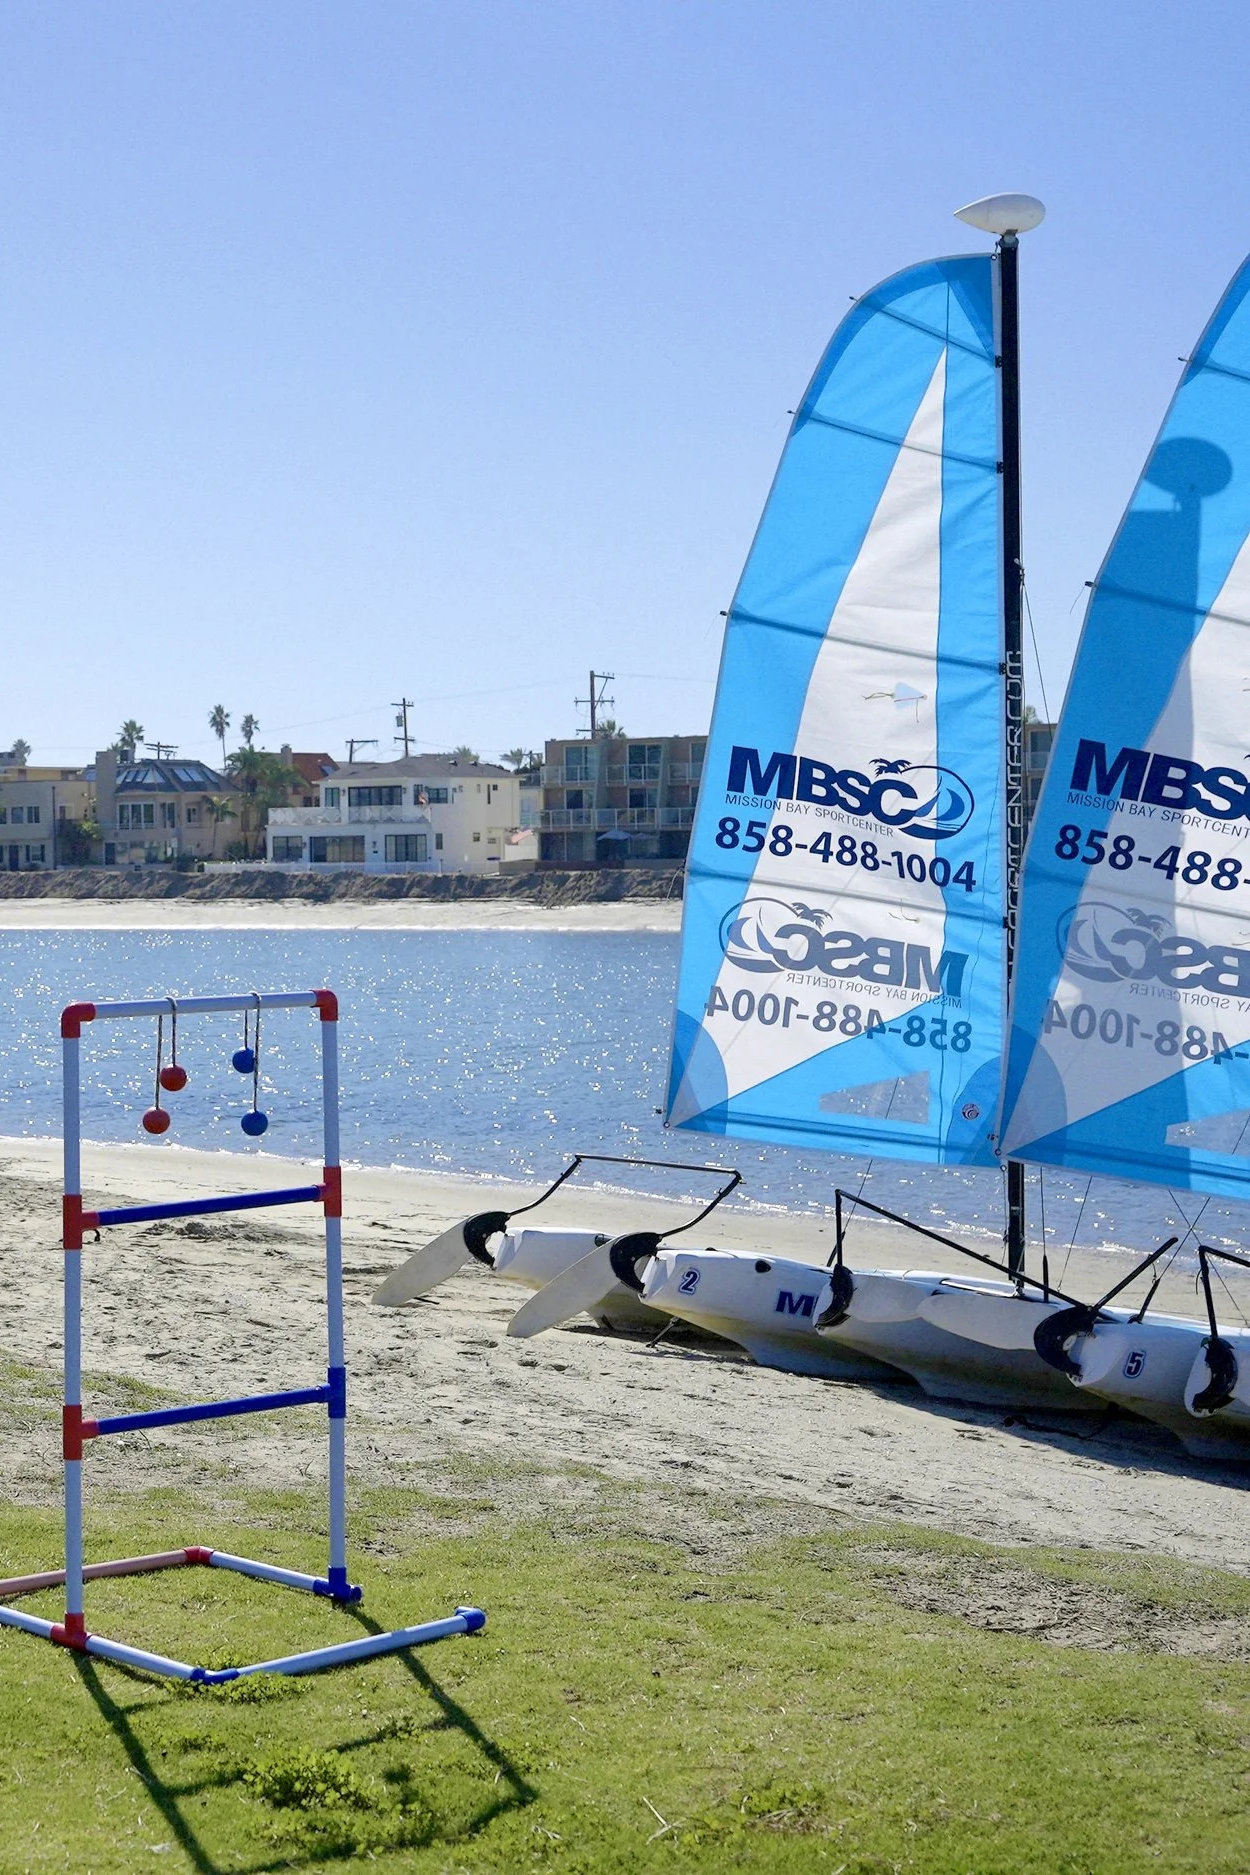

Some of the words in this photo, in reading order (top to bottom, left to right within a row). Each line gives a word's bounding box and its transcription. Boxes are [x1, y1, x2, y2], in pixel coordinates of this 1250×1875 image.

[726, 745, 918, 826] MBSC
[1069, 738, 1250, 821] MBS
[725, 793, 781, 811] MISSION
[786, 801, 811, 815] BAY
[815, 807, 894, 838] SPORTCENTER
[1067, 792, 1124, 812] MISSION
[1129, 802, 1157, 817] BAY
[715, 816, 977, 893] 858-488-1004
[679, 1268, 699, 1294] 2
[775, 1291, 819, 1317] M
[1125, 1351, 1145, 1377] 5
